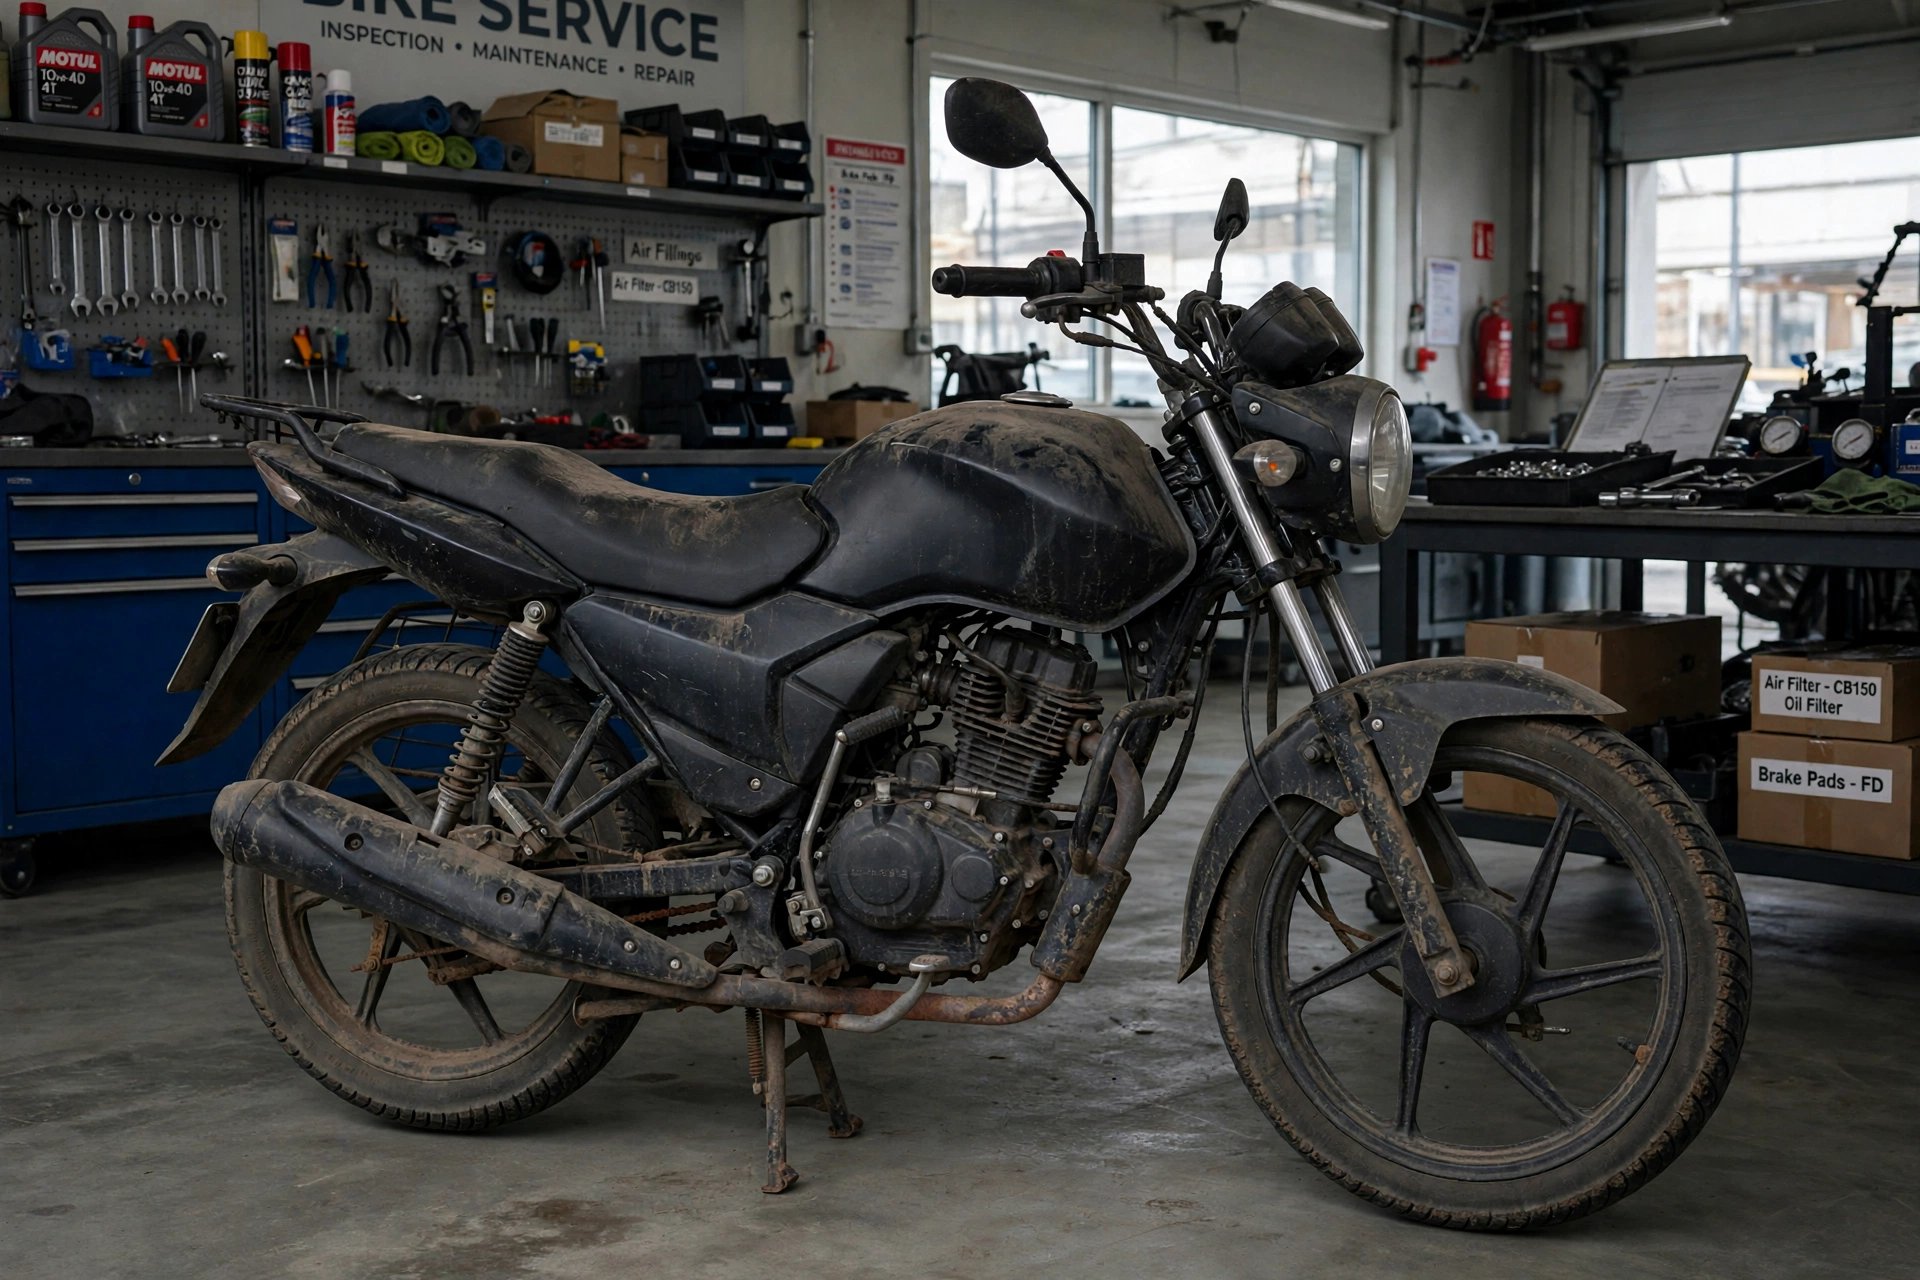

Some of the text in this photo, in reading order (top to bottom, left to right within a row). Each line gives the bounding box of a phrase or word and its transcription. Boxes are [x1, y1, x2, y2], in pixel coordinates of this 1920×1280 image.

[478, 0, 719, 62] SERVICE
[39, 49, 97, 69] MOTUL
[321, 20, 696, 87] INSPECTION MAINTENANCE REPAIR
[148, 61, 202, 80] MOTUL
[630, 241, 651, 259] Air
[662, 279, 693, 295] CB150
[1764, 674, 1784, 690] Air
[1787, 676, 1821, 693] Filter
[1833, 680, 1877, 697] CB150
[1785, 696, 1843, 715] Oil Filter
[1758, 765, 1801, 785] Brake
[1807, 770, 1845, 790] Pads
[1861, 776, 1884, 793] FD
